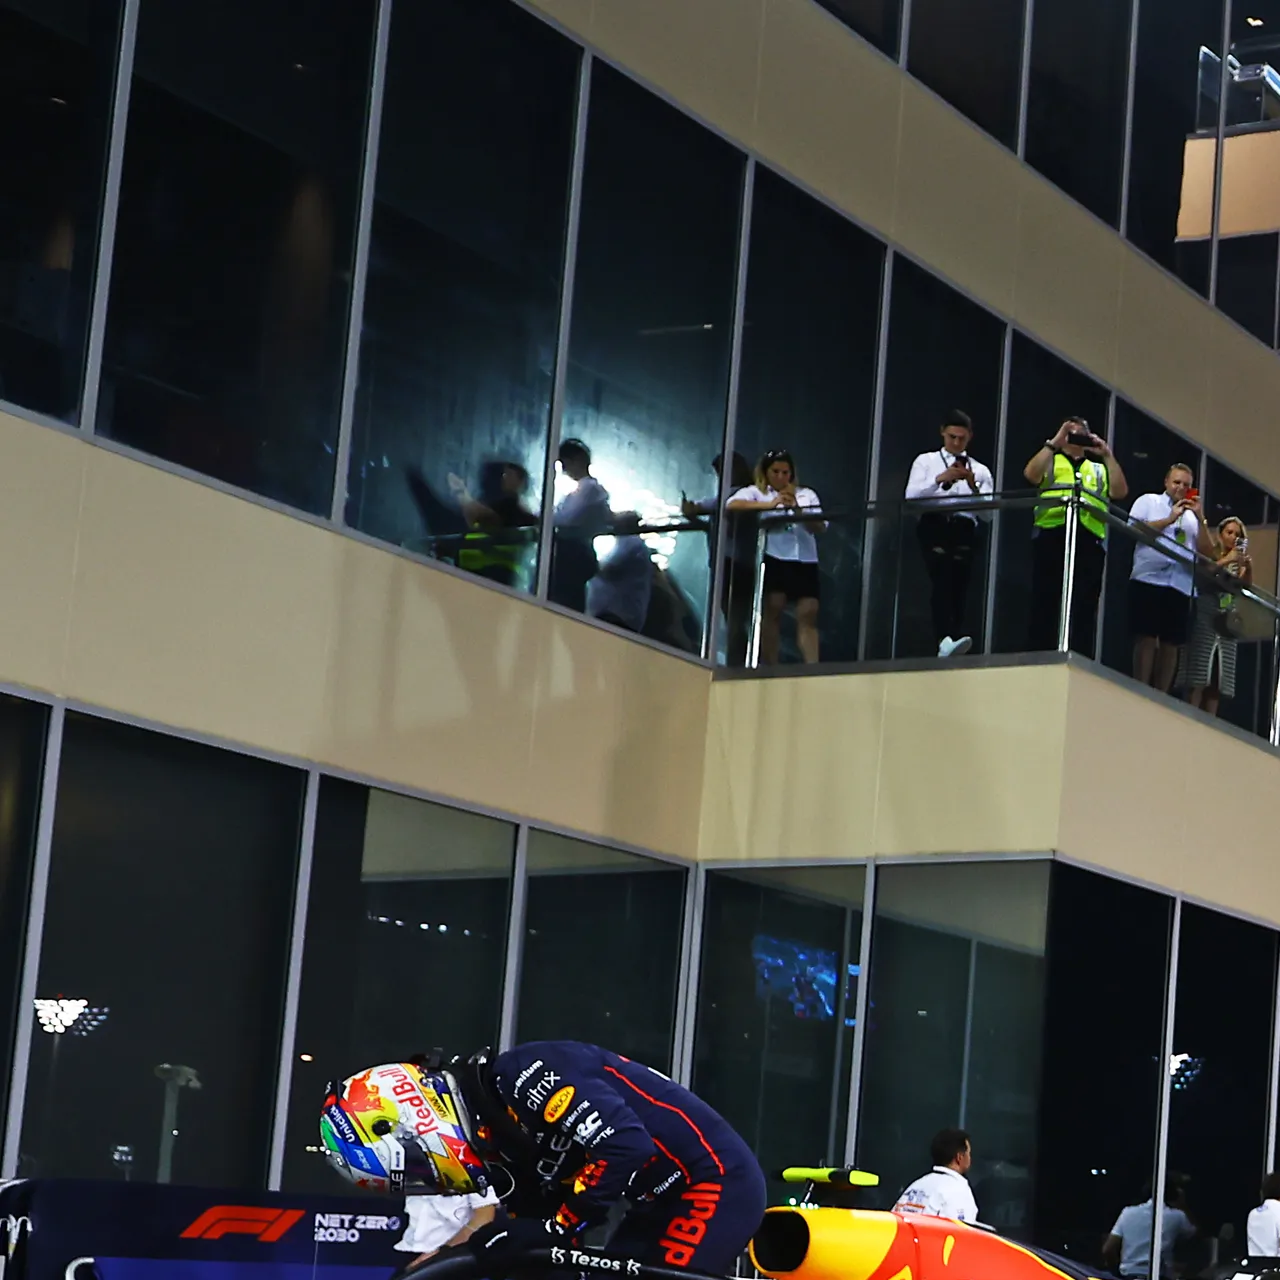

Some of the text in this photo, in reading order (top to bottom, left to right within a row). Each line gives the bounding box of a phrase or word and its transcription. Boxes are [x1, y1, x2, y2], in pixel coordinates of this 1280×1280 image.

[527, 1071, 561, 1112] citrix
[314, 1213, 401, 1231] NET ZERO
[314, 1227, 360, 1242] 2030
[570, 1250, 621, 1272] Tezos
